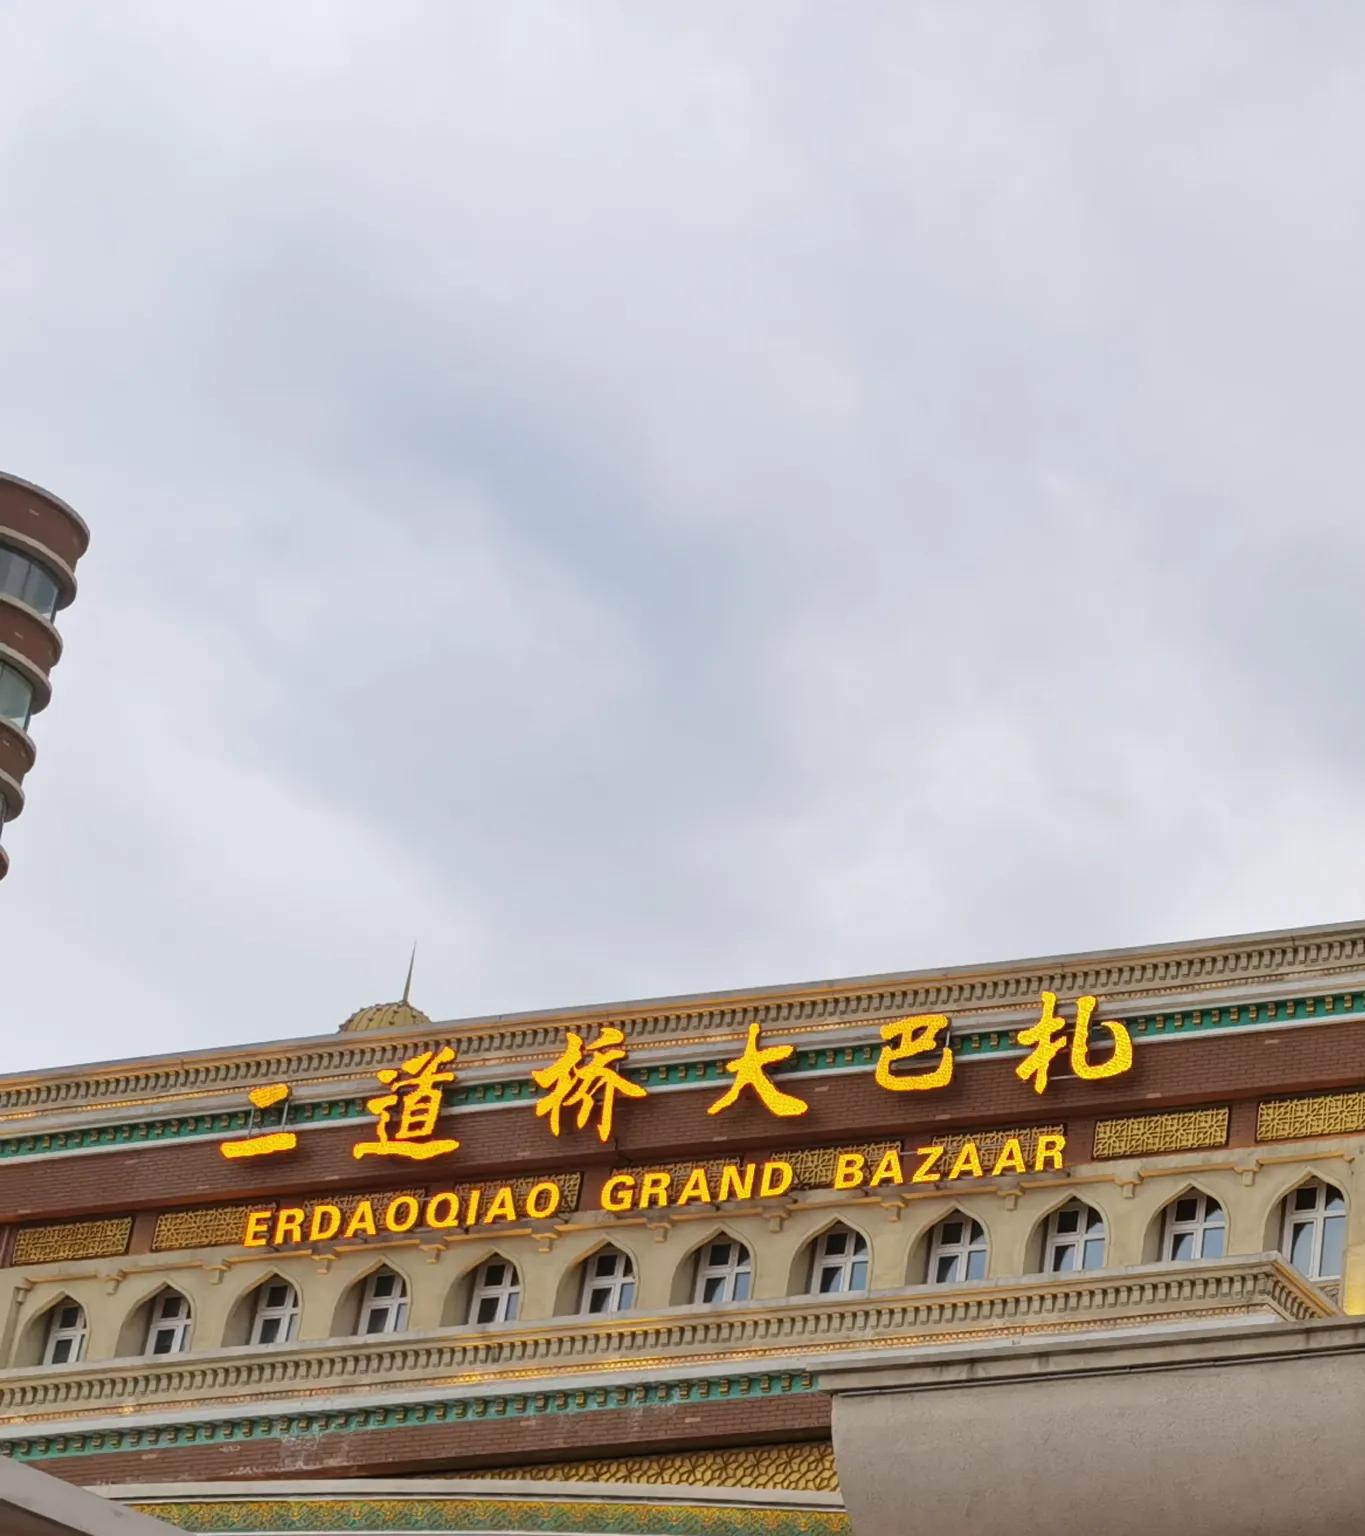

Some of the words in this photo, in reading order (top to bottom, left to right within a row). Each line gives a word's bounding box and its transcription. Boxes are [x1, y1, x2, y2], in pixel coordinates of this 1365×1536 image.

[220, 991, 1133, 1162] 二道桥大巴扎
[243, 1182, 560, 1247] ERDAOQIAO
[600, 1161, 793, 1211] GRAND
[833, 1134, 1066, 1190] BAZAAR
